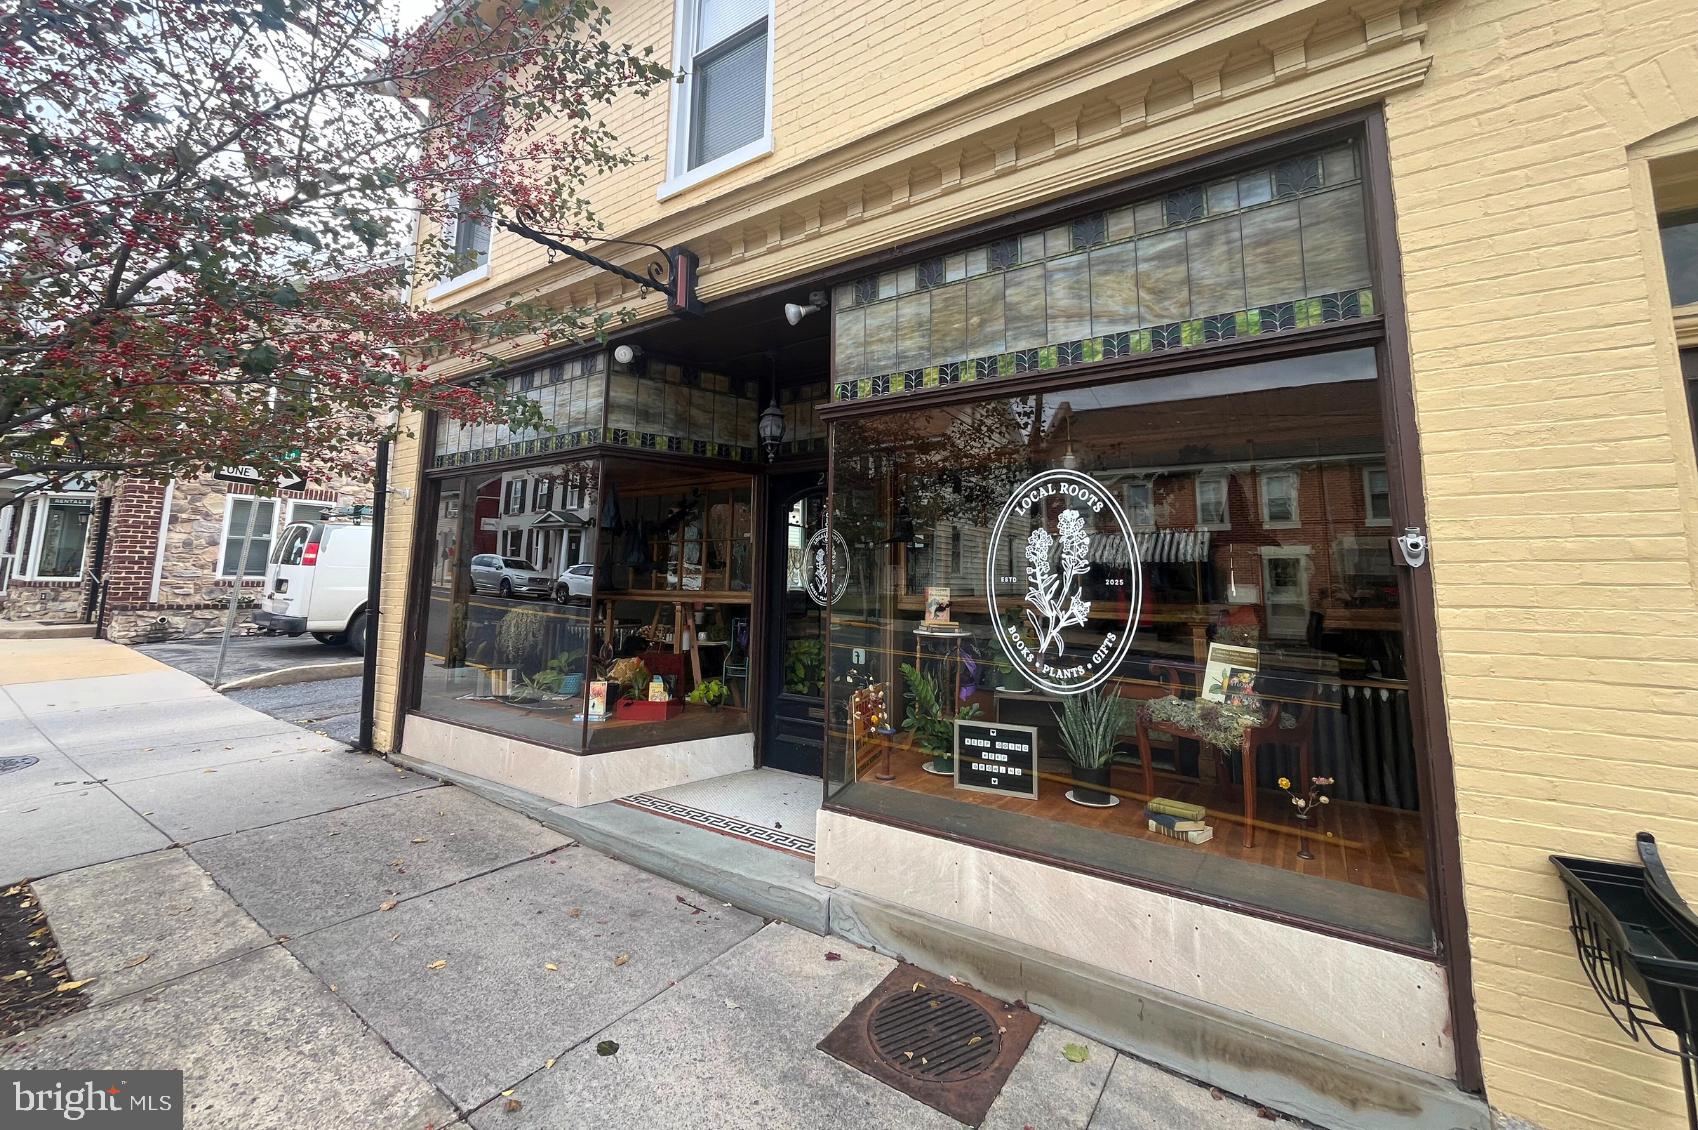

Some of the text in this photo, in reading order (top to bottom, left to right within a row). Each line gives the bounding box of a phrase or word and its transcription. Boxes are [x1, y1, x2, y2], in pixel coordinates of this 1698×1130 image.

[227, 465, 251, 477] ONE
[1015, 482, 1104, 516] LOCAL ROOTS
[1008, 625, 1117, 679] BOOKS PLANTS GIFTS
[996, 741, 1029, 752] GOING
